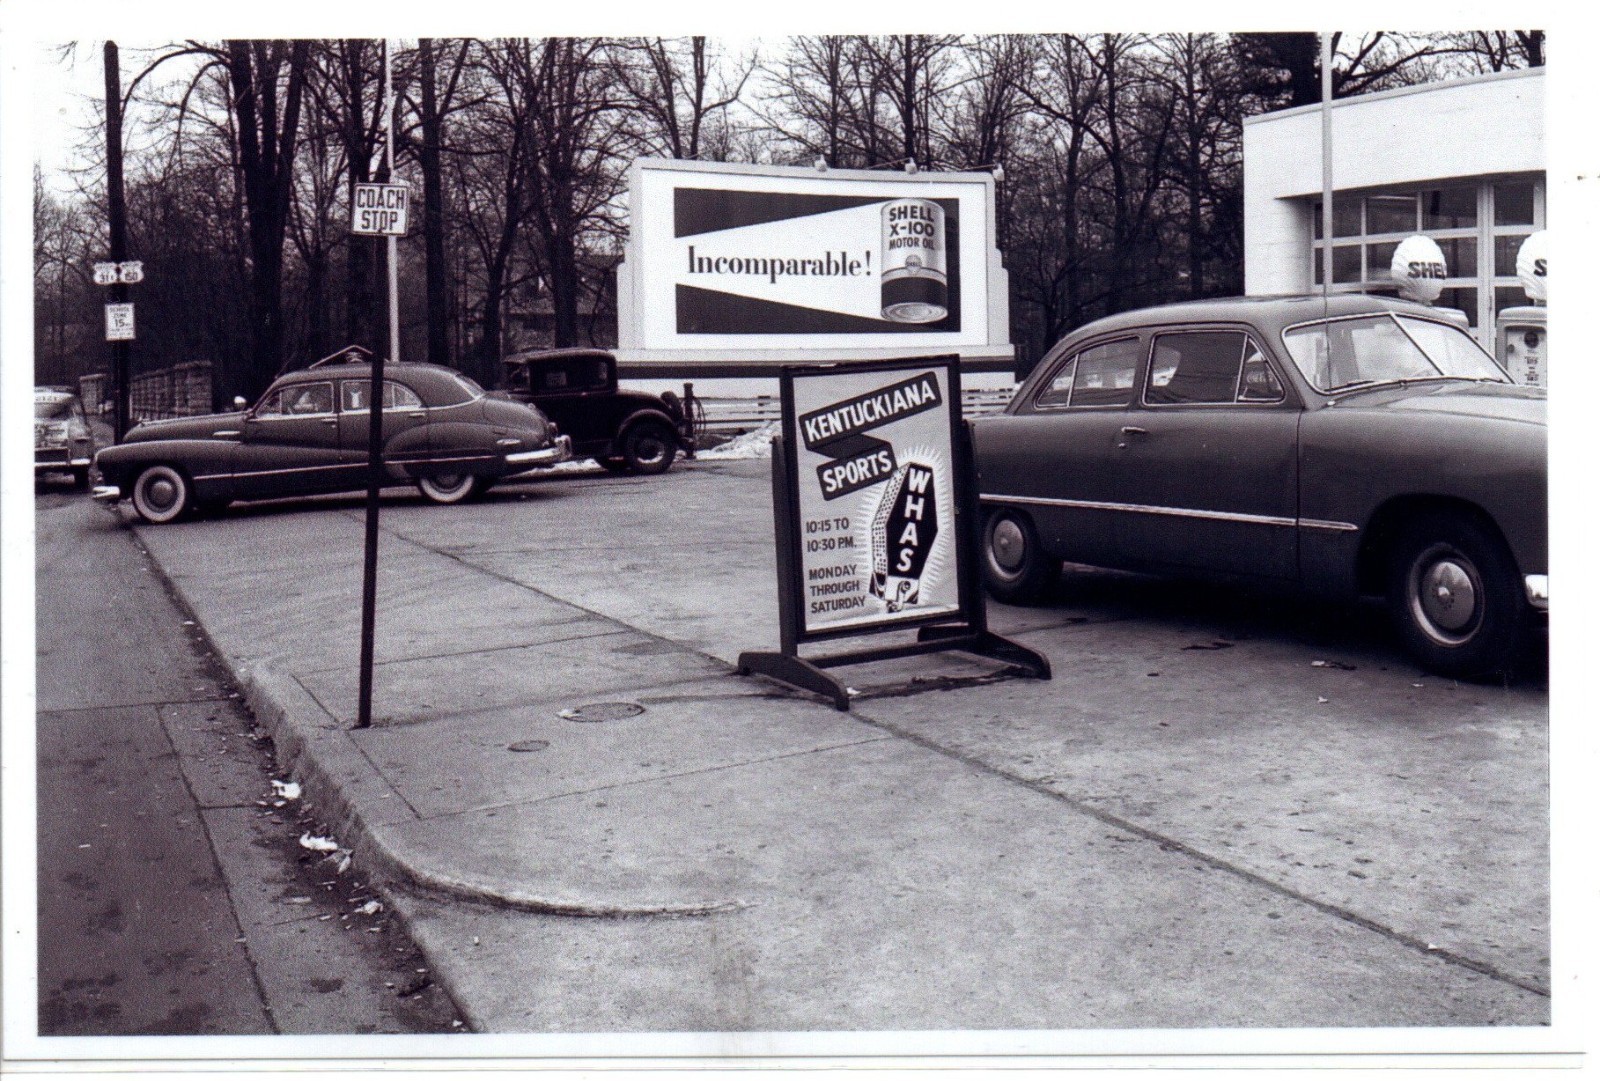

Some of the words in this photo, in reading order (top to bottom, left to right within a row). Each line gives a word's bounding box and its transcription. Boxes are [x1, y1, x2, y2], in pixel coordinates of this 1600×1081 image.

[357, 188, 405, 209] COACH
[361, 210, 398, 231] STOP
[889, 205, 935, 222] SHELL
[889, 221, 935, 237] X-100
[889, 237, 920, 251] MOTOR
[922, 238, 935, 251] OIL
[688, 245, 872, 284] Incomparable!
[114, 318, 125, 328] 15
[805, 380, 936, 442] KENTUCKIANA
[823, 451, 892, 493] SPORTS
[806, 519, 831, 534] 10:15
[833, 517, 850, 530] TO
[896, 468, 931, 572] WHAS
[806, 538, 836, 553] 10:30
[808, 564, 858, 581] MONDAY
[810, 580, 860, 597] THROUGH
[811, 596, 867, 614] SATURDAY
